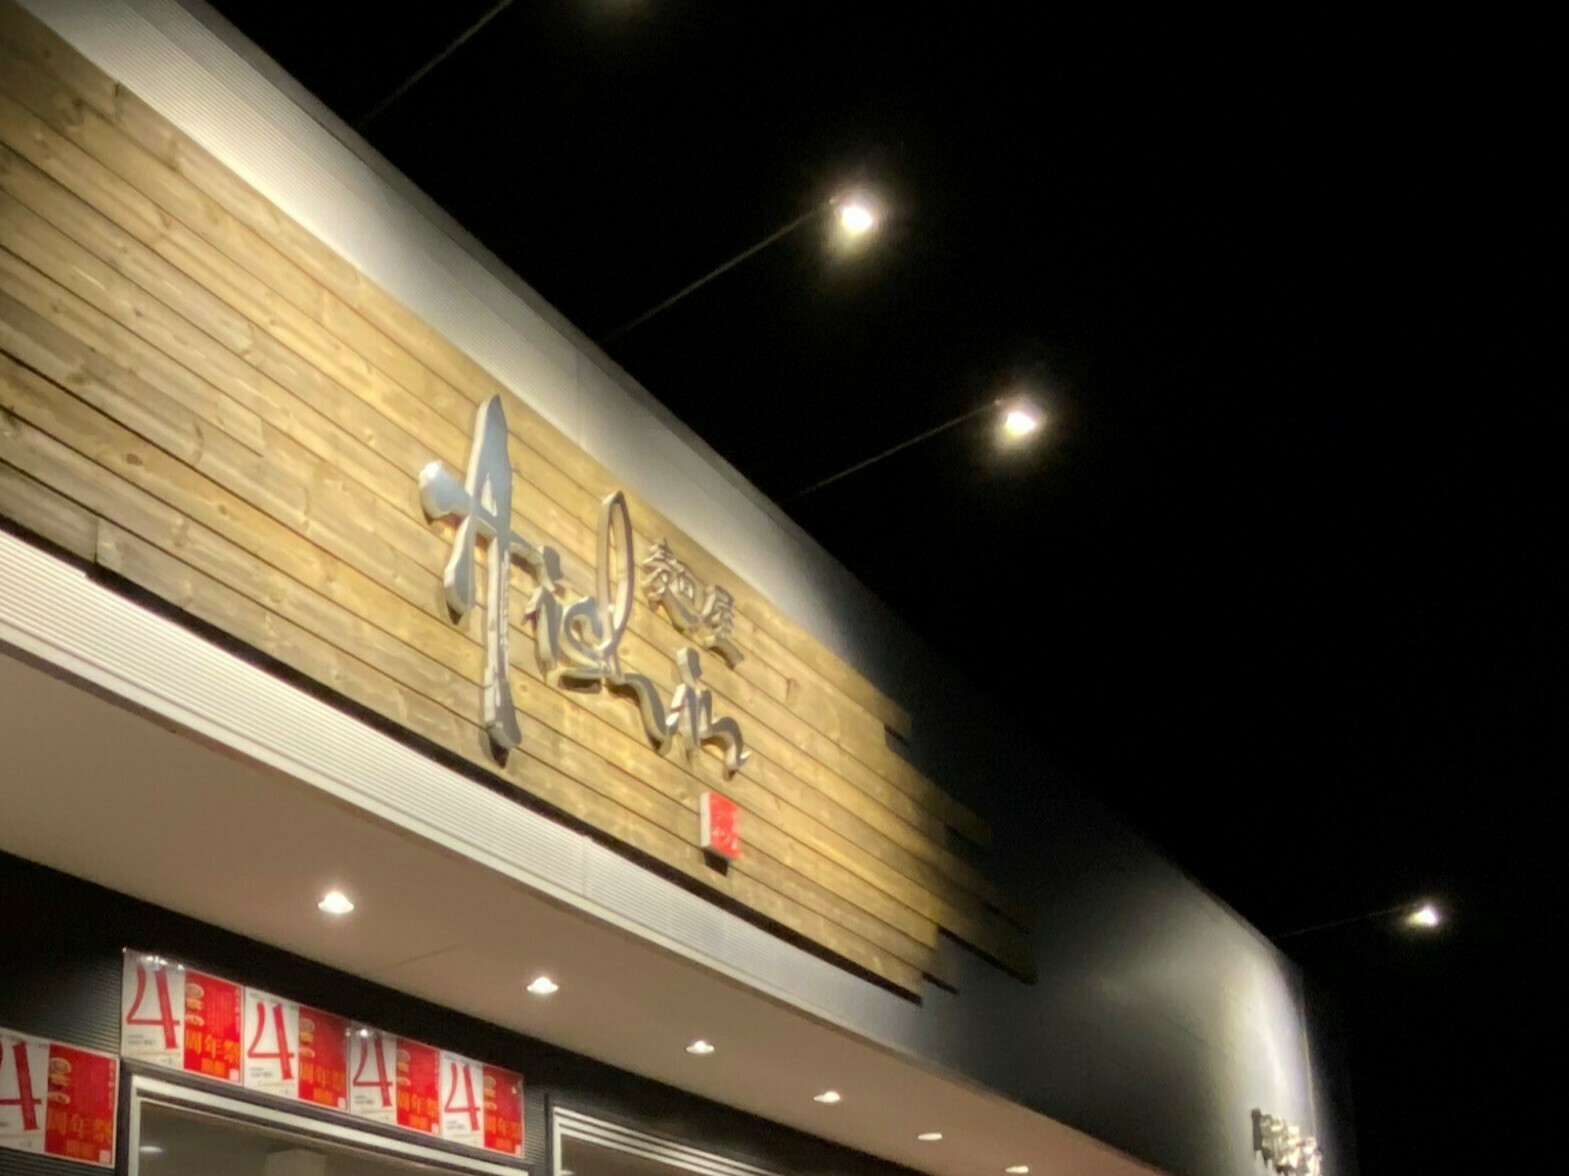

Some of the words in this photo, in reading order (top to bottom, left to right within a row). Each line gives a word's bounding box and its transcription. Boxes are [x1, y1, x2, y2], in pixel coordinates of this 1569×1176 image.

[418, 394, 752, 782] Aishin
[126, 966, 180, 1050] 4
[247, 1001, 295, 1081] 4
[353, 1037, 393, 1107] 4
[444, 1062, 480, 1131] 4
